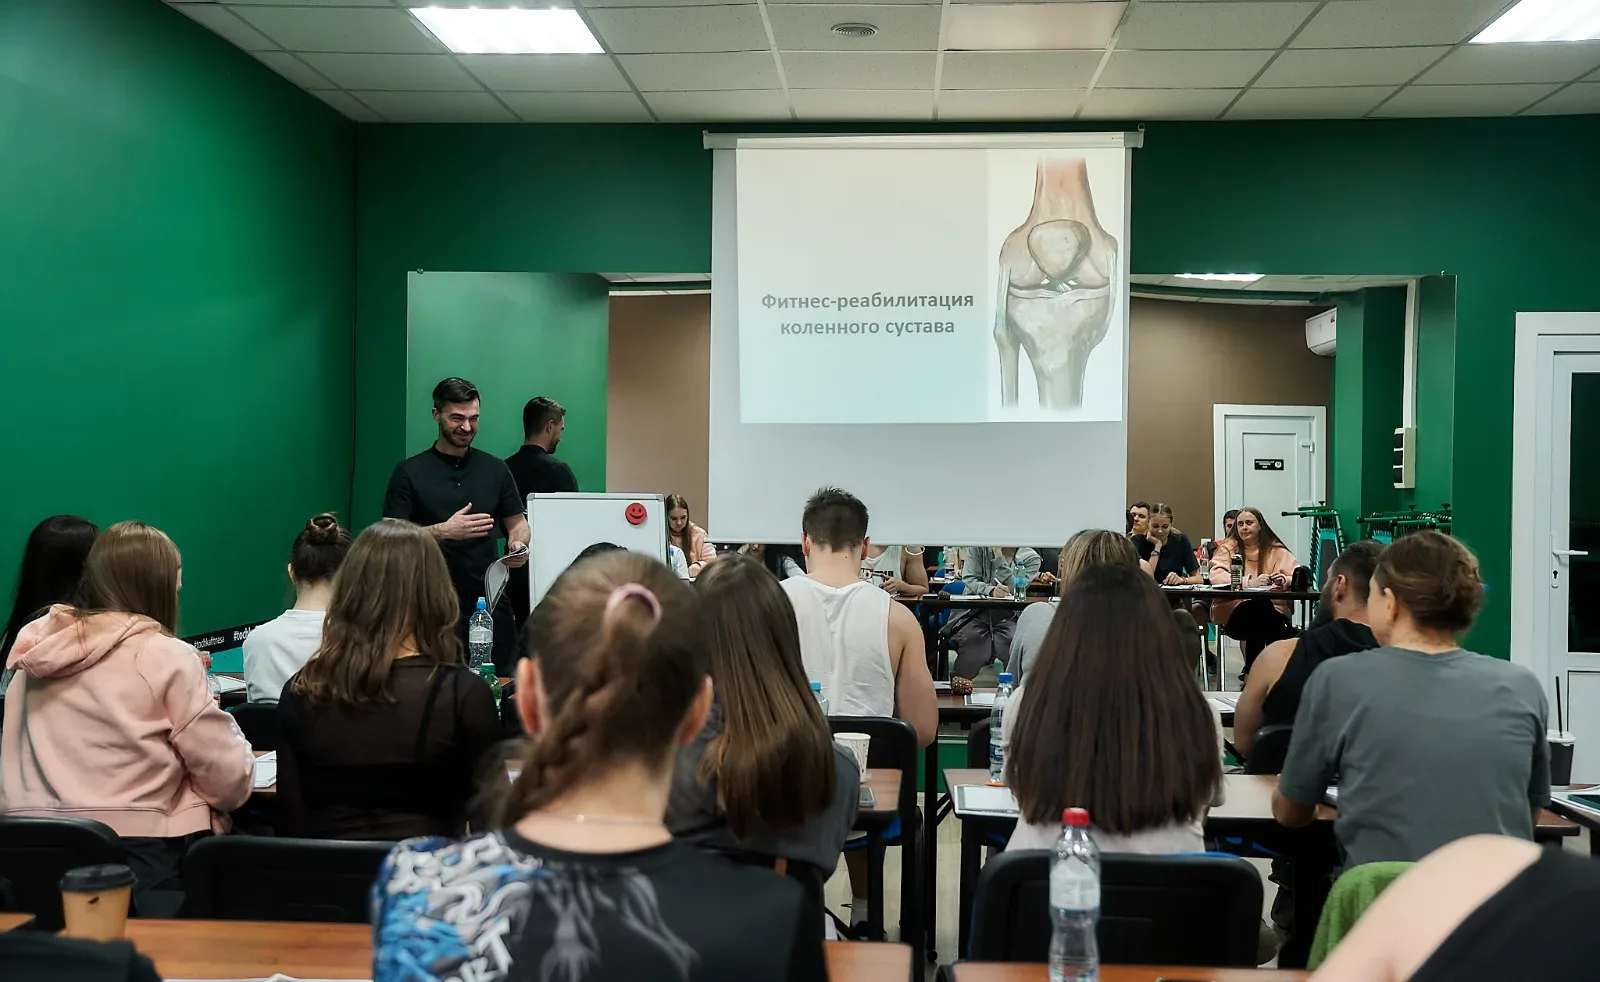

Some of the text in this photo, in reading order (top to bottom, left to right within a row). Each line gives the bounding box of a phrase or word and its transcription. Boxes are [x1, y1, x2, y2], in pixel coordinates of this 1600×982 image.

[761, 292, 974, 311] Фитнес-реабилитация
[781, 320, 955, 337] коленного сустава
